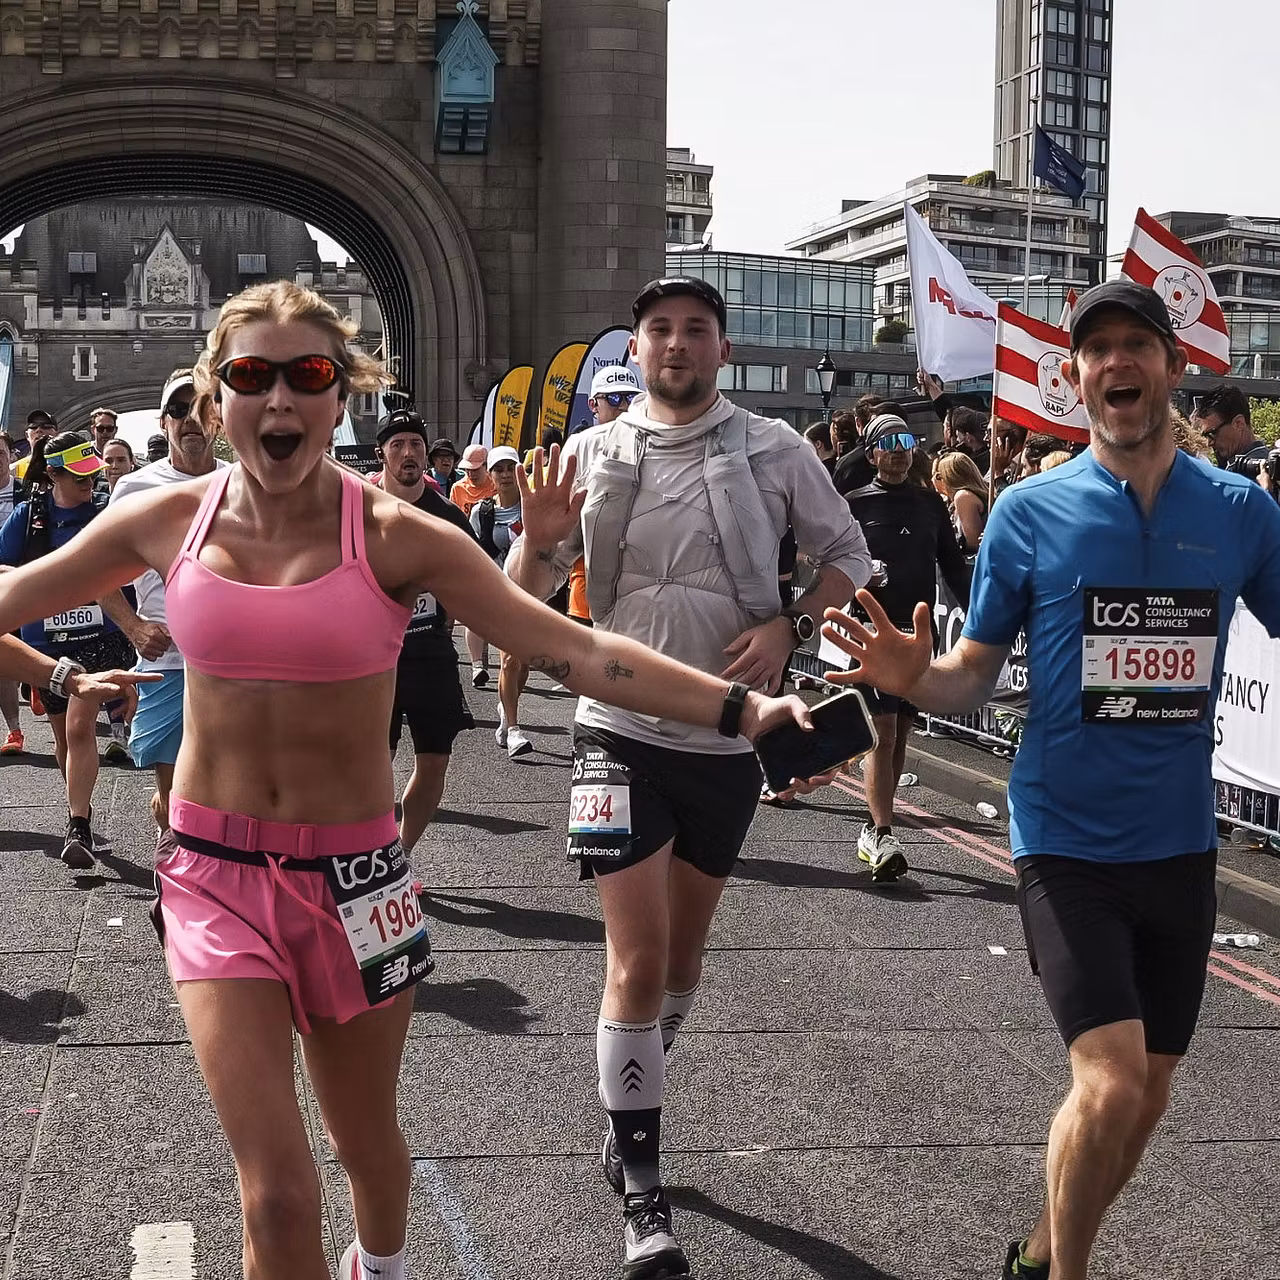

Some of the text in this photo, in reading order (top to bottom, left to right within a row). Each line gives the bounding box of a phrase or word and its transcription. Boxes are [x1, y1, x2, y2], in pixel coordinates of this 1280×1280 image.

[592, 356, 622, 367] North
[606, 372, 635, 384] ciele
[1146, 597, 1175, 606] TATA
[1093, 596, 1140, 627] tcs
[1145, 607, 1212, 618] CONSULTANCY
[53, 610, 93, 626] 60560
[1145, 618, 1189, 628] SERVICES
[1105, 647, 1196, 681] 15898
[1136, 708, 1199, 718] new balance
[586, 752, 604, 760] TATA
[572, 757, 584, 781] cs
[584, 761, 631, 772] CONSULTANCY
[583, 770, 609, 779] SERVICES
[583, 846, 621, 856] balance
[332, 849, 389, 890] tcs
[411, 959, 428, 977] new
